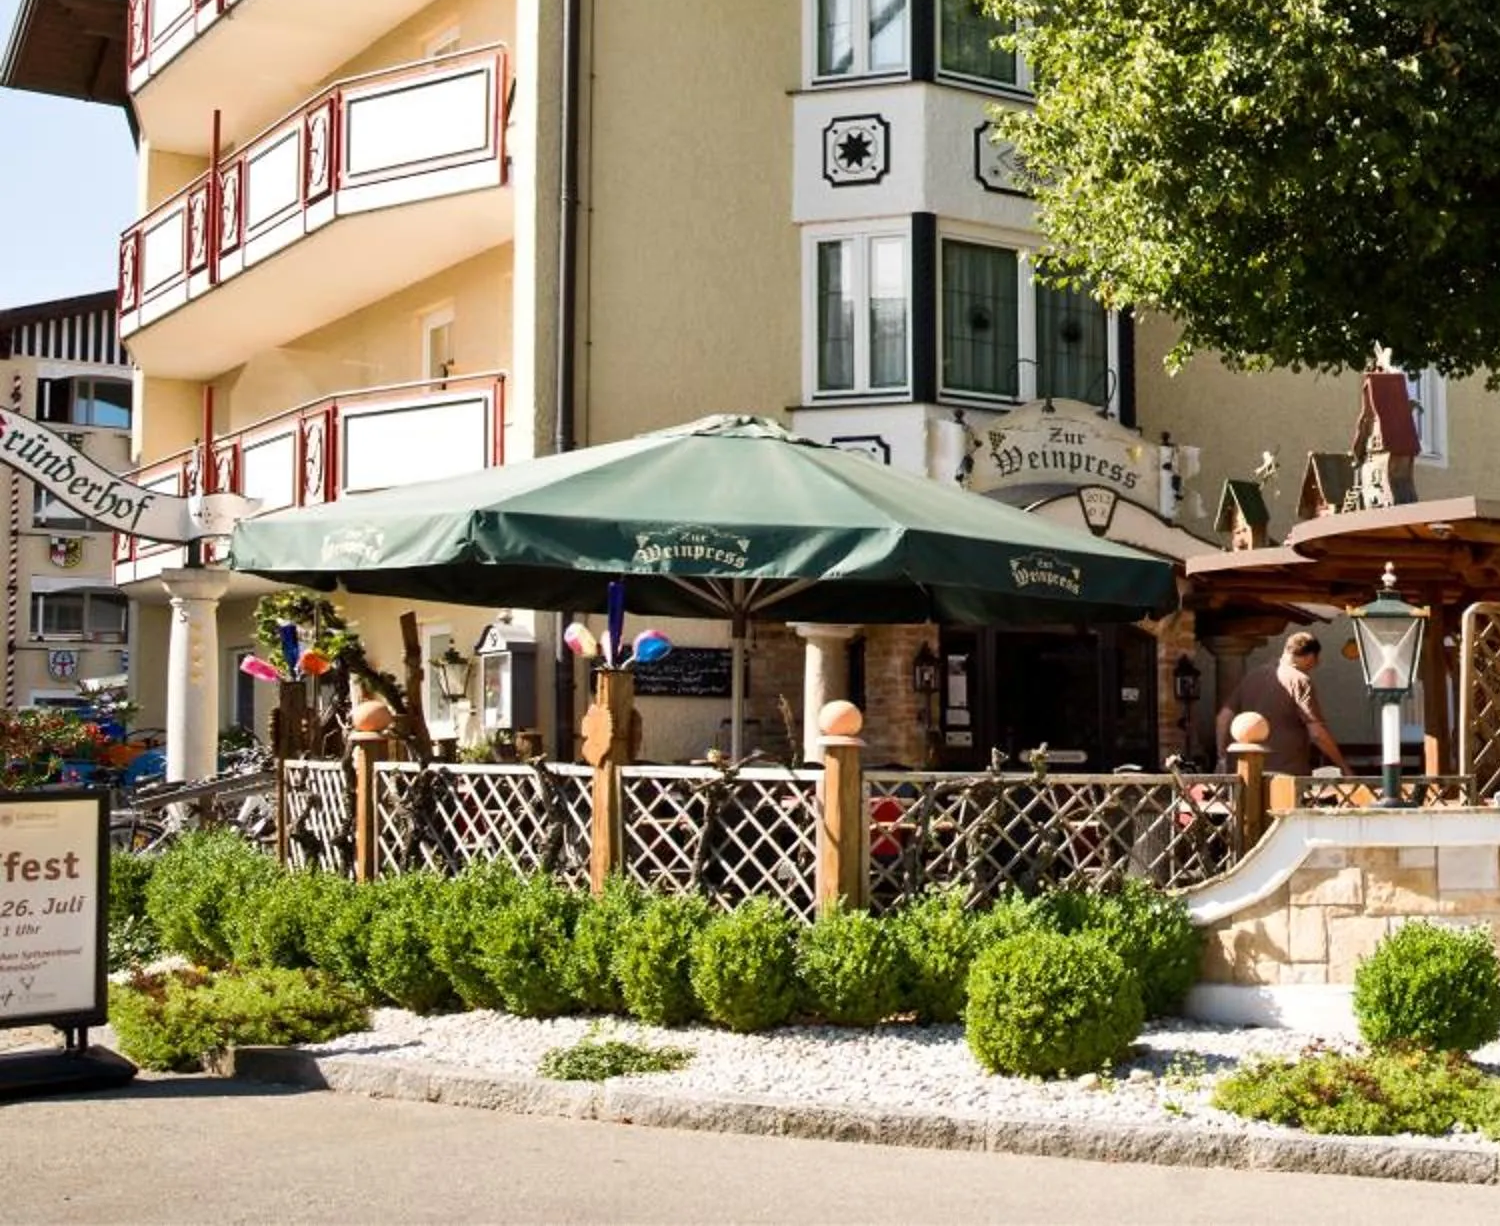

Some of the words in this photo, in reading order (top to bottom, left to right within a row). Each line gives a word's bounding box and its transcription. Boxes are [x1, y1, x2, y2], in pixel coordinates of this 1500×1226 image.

[1049, 427, 1086, 445] Zur
[0, 415, 154, 531] ründerhof
[989, 445, 1140, 490] Weinpress
[632, 542, 747, 569] Weinpress
[0, 851, 80, 883] fest
[42, 895, 87, 915] Juli
